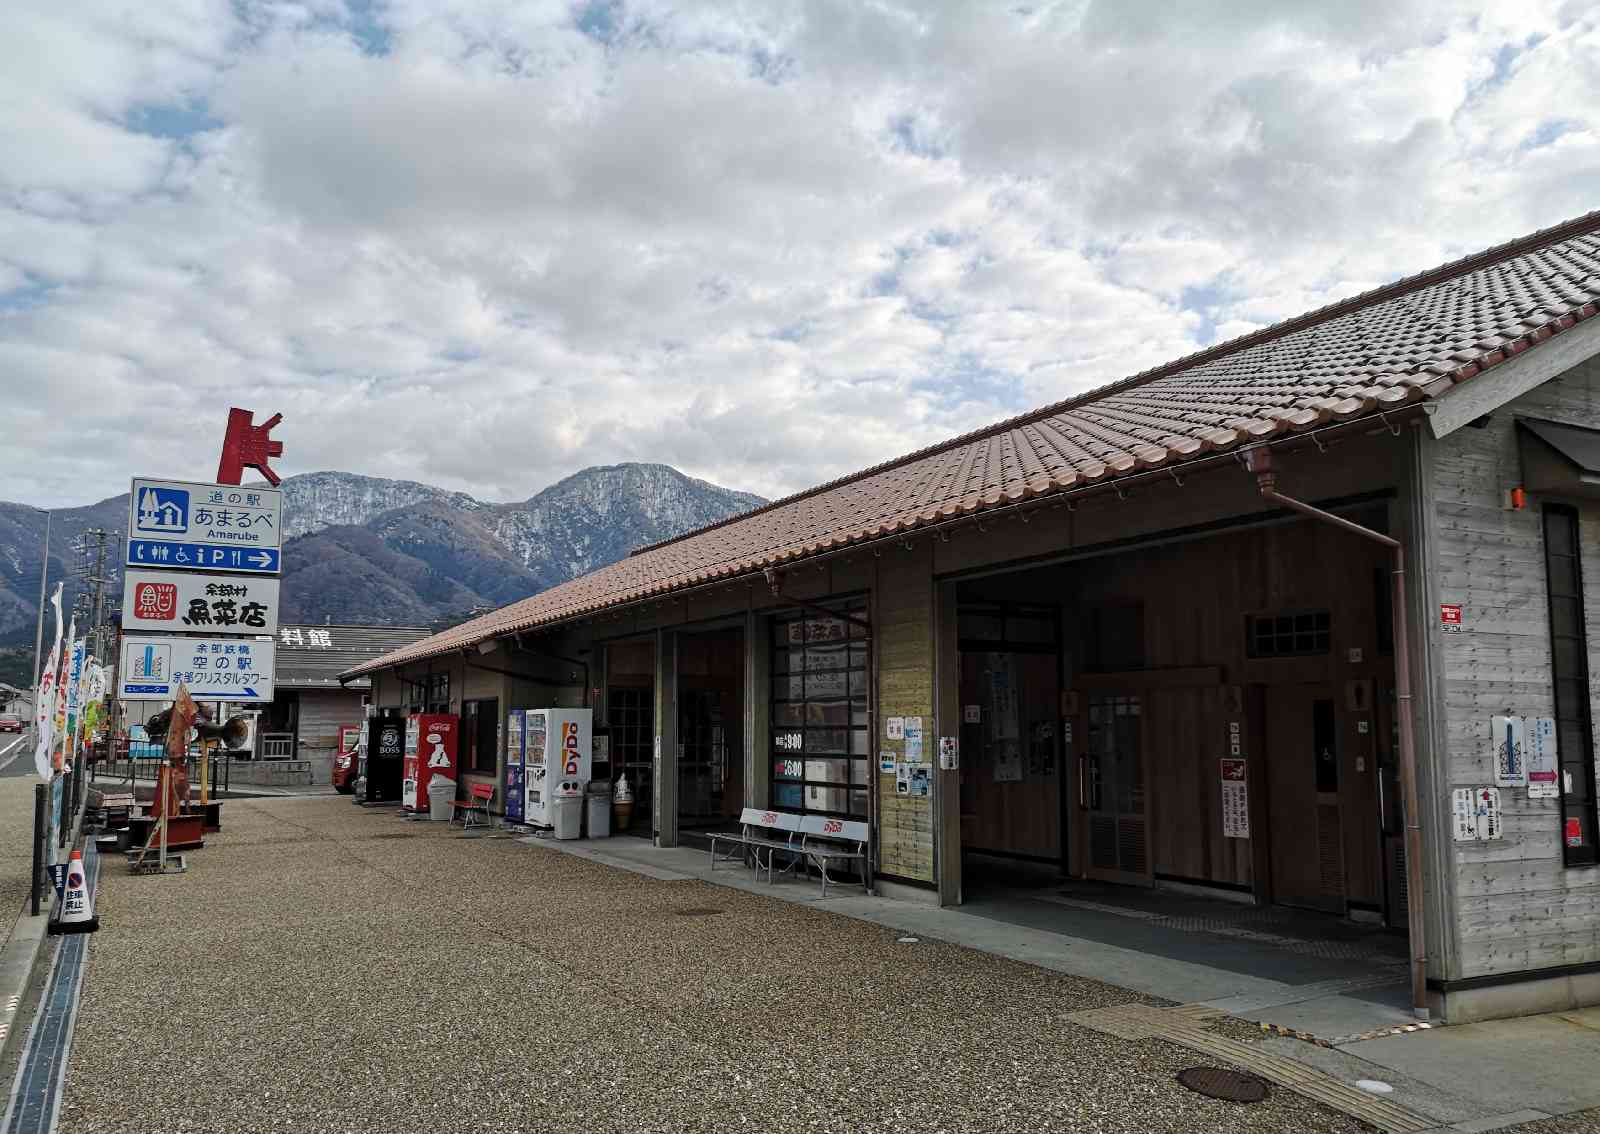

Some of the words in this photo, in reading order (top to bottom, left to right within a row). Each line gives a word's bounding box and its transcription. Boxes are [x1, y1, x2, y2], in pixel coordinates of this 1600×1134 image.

[209, 491, 260, 506] 道の駅
[194, 508, 273, 528] あまるべ
[207, 529, 259, 541] Amarube
[182, 598, 268, 628] 魚菜店
[280, 627, 332, 647] 料館
[197, 643, 250, 655] 余部鉄橋
[192, 656, 252, 670] 空の駅
[172, 671, 269, 685] 余部クリスタルタワー
[379, 746, 400, 754] BOSS
